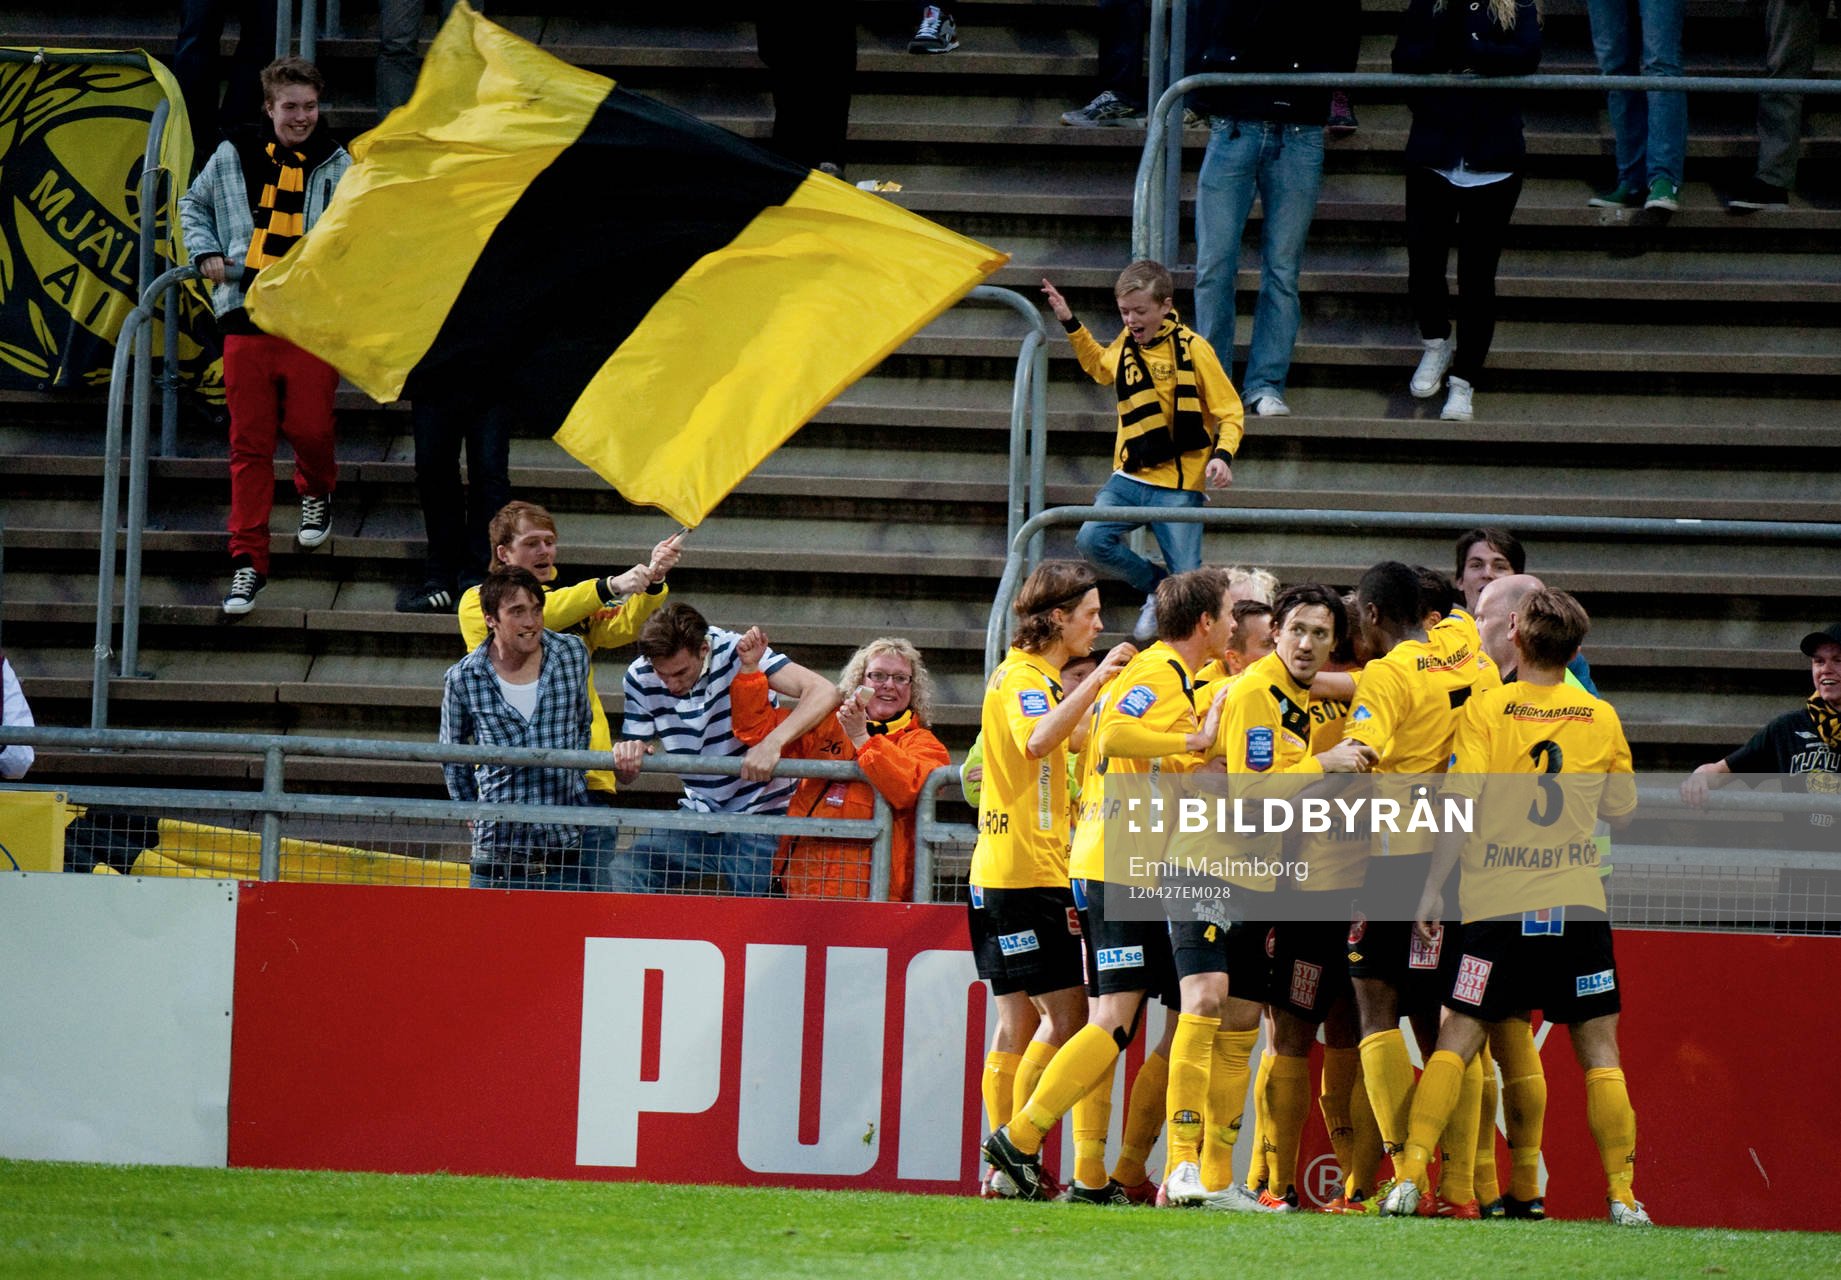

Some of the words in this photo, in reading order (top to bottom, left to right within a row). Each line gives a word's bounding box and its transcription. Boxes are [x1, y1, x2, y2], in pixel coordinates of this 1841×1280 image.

[819, 739, 842, 755] 26
[1527, 739, 1564, 828] 3
[1483, 843, 1563, 869] RINKABY
[1000, 934, 1037, 950] BLT.se
[1203, 924, 1217, 943] 4
[1099, 950, 1143, 965] BLT.se
[1461, 958, 1489, 977] SYD
